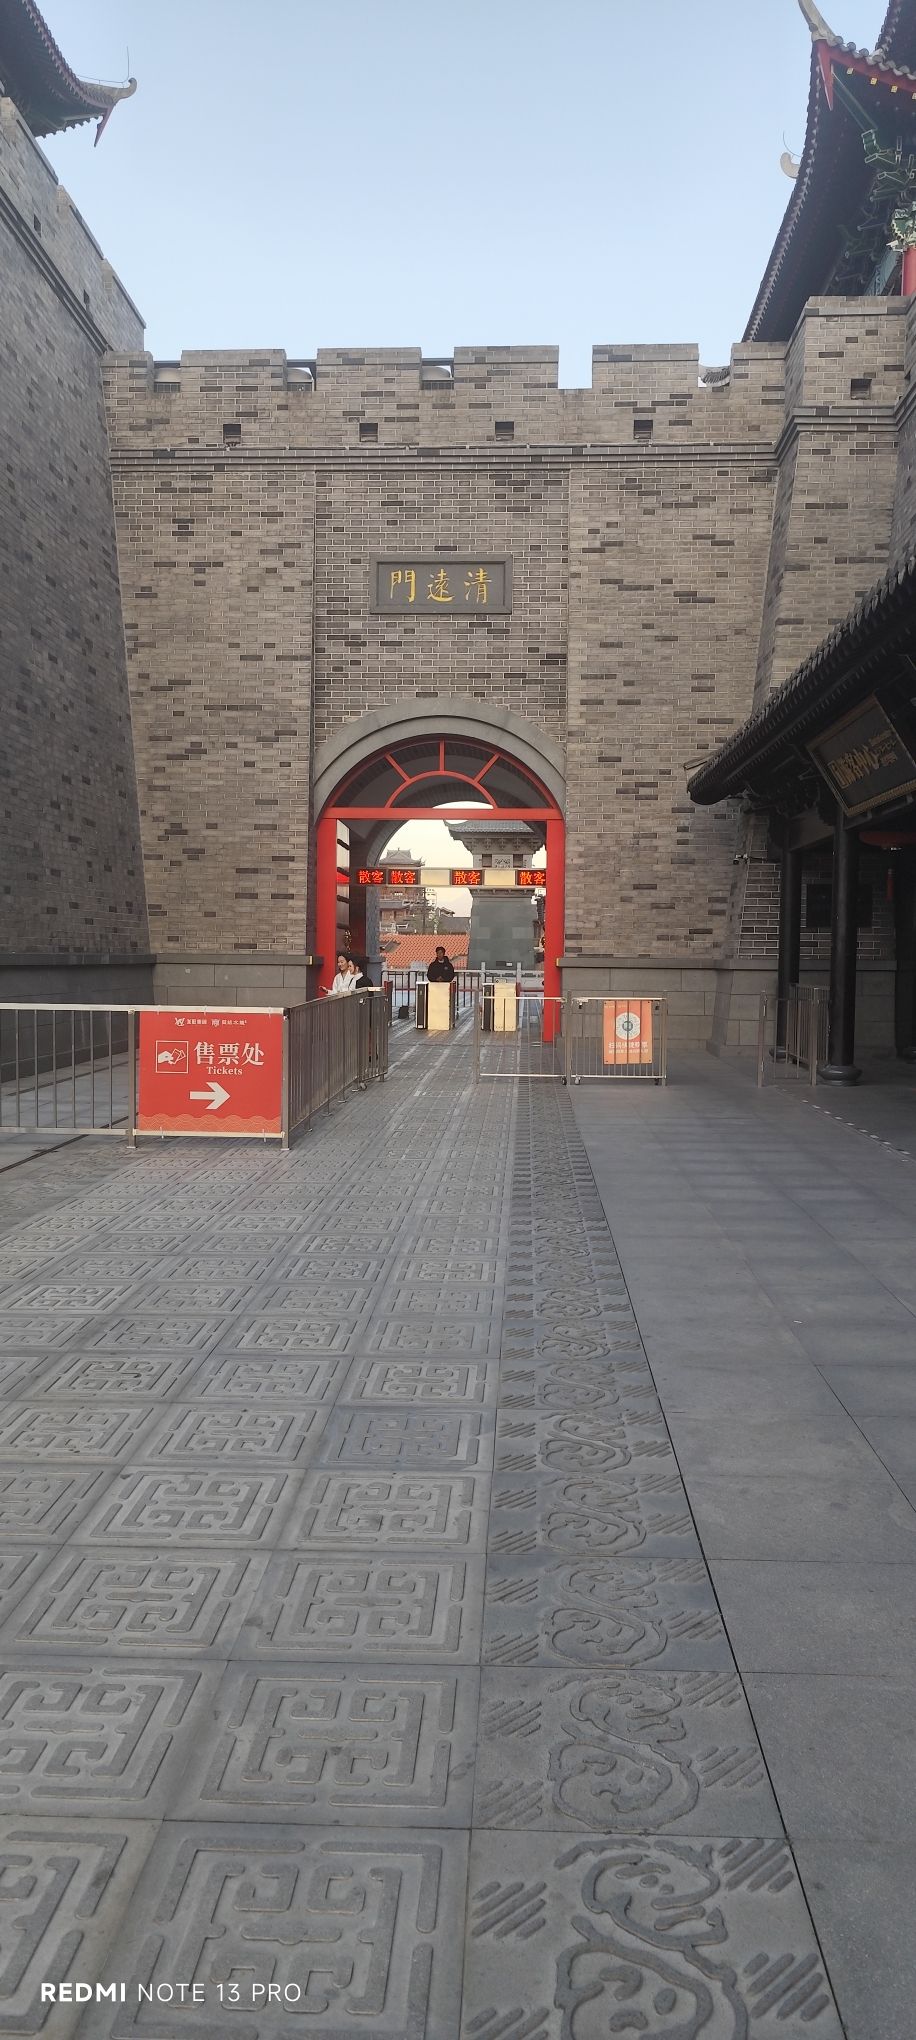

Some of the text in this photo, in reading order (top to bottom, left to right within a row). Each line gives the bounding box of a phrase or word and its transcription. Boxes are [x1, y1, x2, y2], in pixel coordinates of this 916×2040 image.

[358, 870, 384, 885] 散客
[390, 870, 416, 885] 散客
[454, 870, 481, 885] 散客
[519, 870, 546, 885] 散客
[193, 1041, 265, 1066] 售票处
[206, 1066, 243, 1075] Tickets
